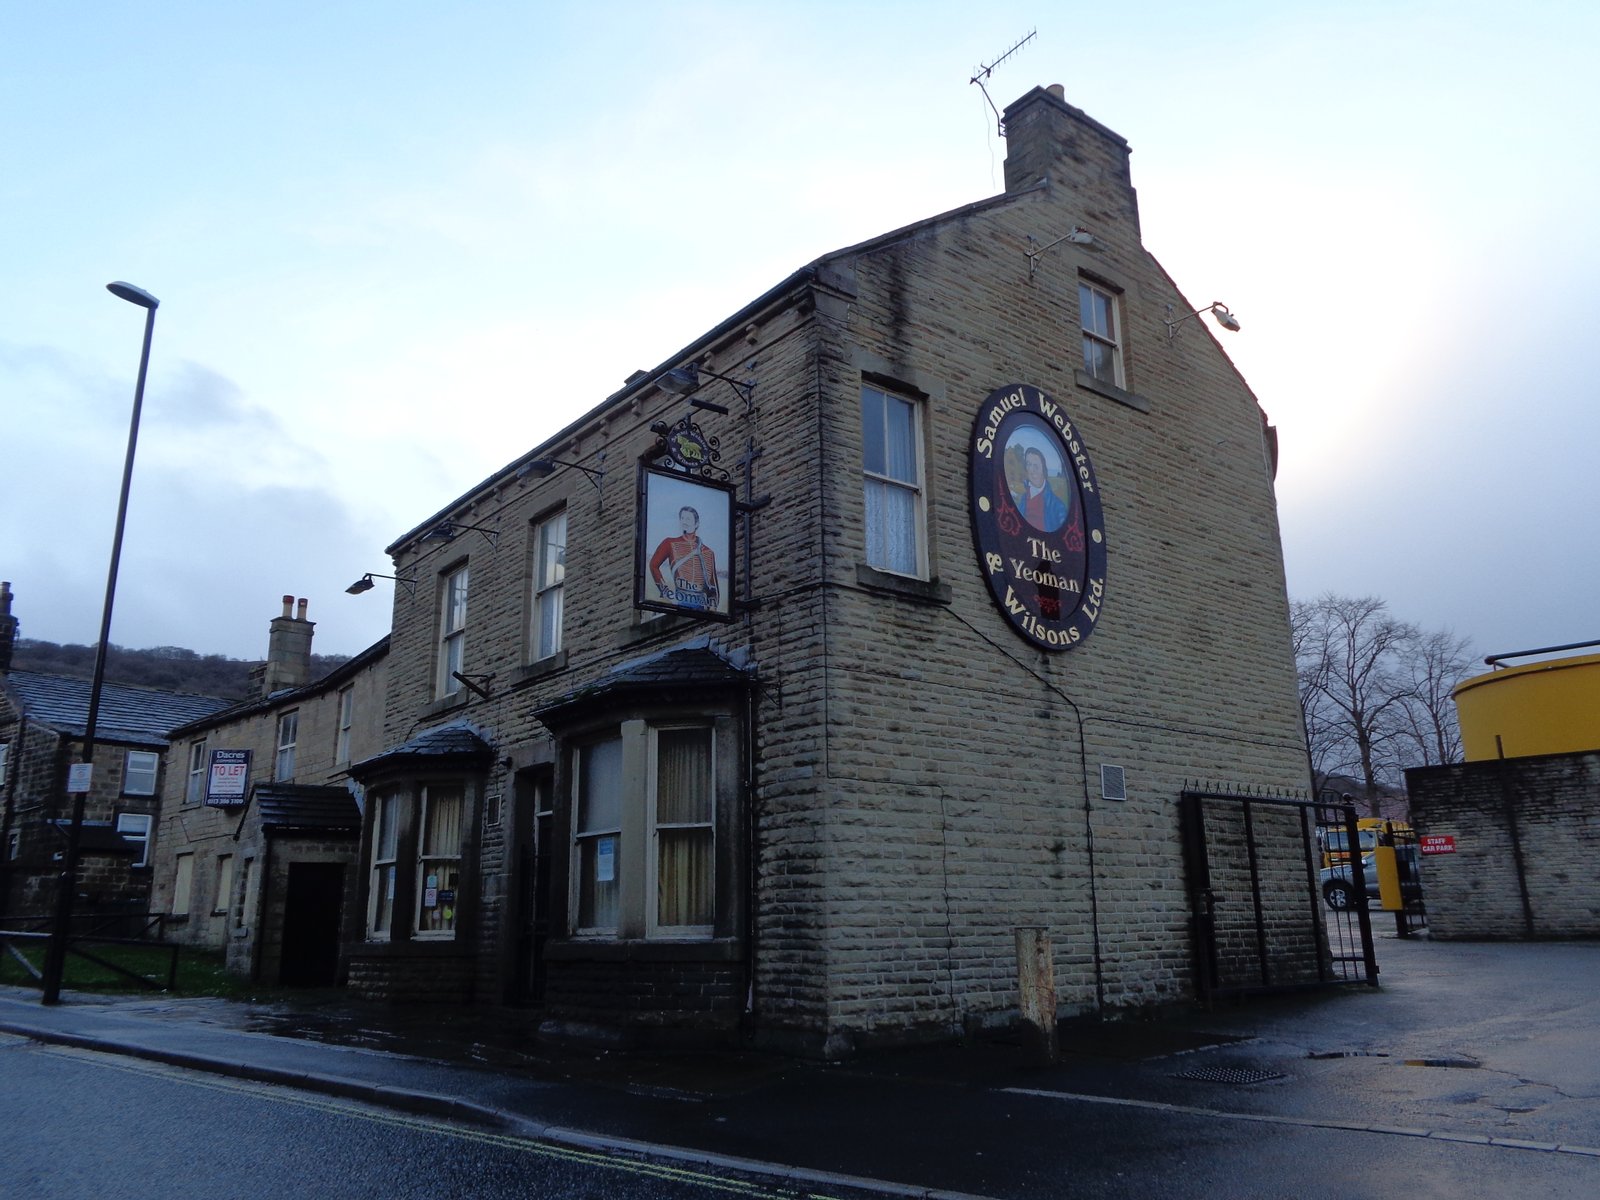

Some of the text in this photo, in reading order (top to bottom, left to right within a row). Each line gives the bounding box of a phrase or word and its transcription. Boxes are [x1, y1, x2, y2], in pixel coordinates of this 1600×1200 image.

[977, 386, 1094, 493] Samuel Webster
[1026, 536, 1062, 564] The
[677, 578, 698, 590] The
[1009, 556, 1081, 594] Yeoman
[656, 583, 718, 608] Yeoman
[985, 551, 1104, 646] & Wilsons Ltd.
[214, 765, 245, 776] TO LET
